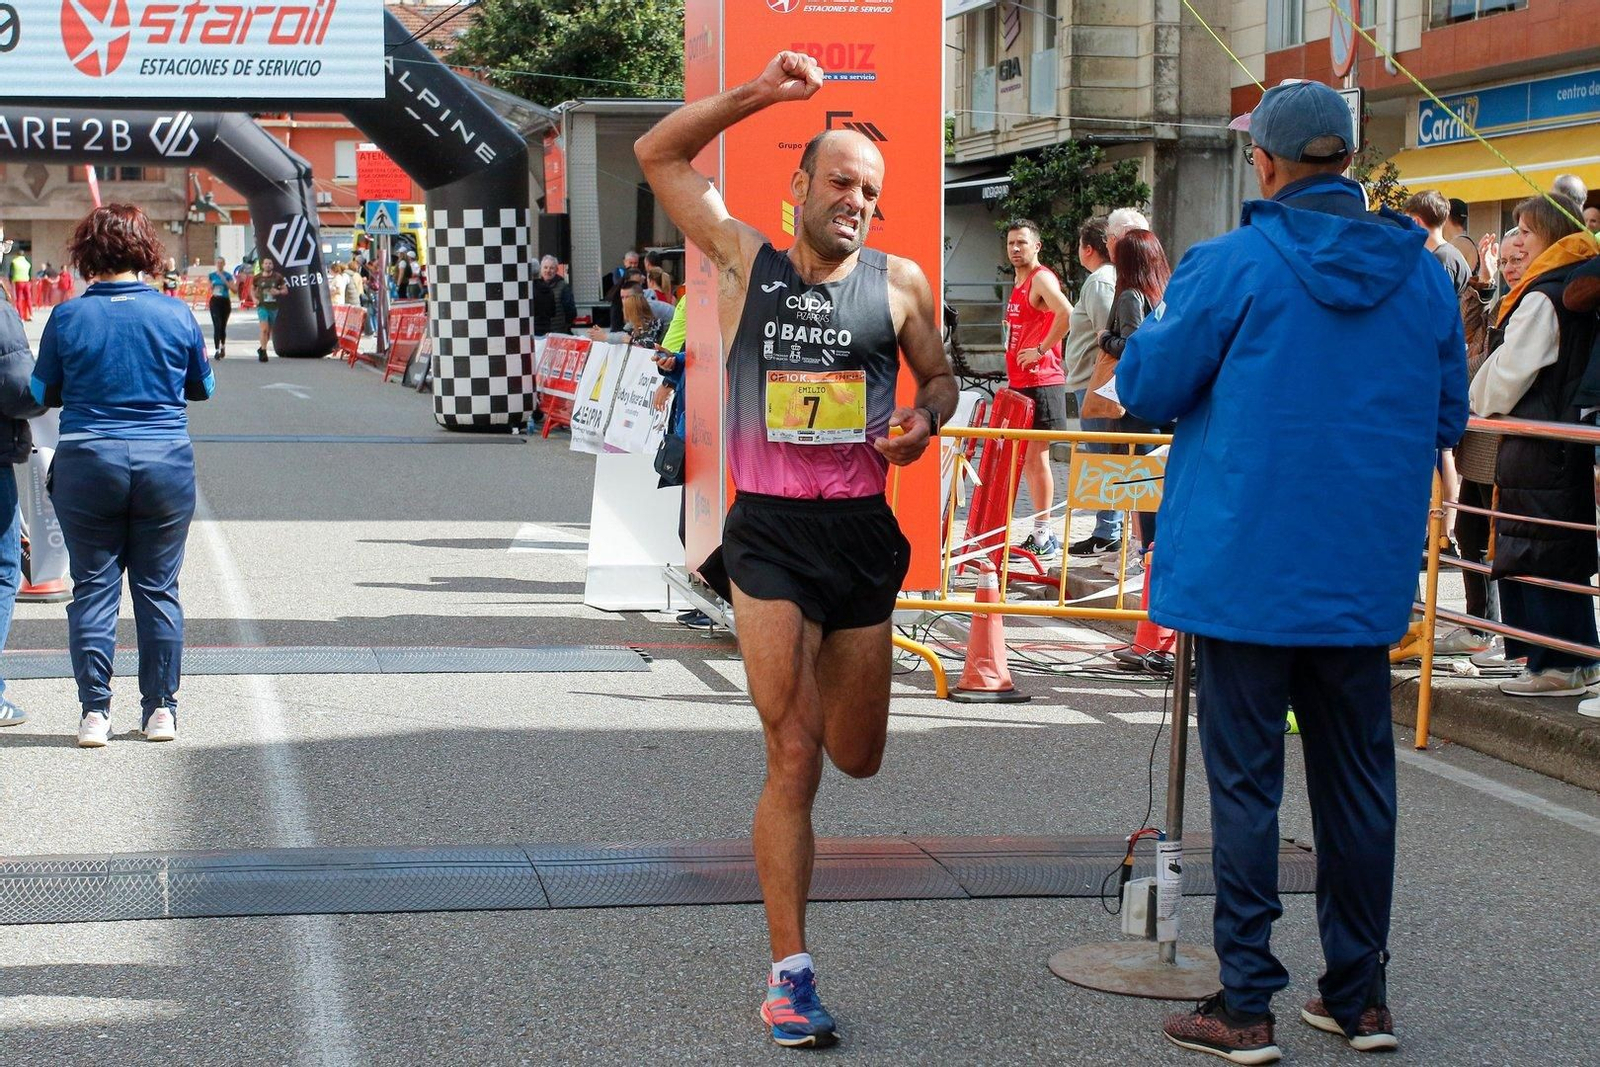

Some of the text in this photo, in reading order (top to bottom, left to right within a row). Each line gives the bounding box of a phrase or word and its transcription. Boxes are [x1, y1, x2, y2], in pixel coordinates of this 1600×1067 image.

[803, 5, 847, 13] ESTACIONES
[139, 0, 338, 45] staroil
[790, 43, 875, 70] ROIZ
[140, 58, 322, 76] ESTACIONES DE SERVICIO
[1556, 80, 1600, 101] centro de
[1419, 105, 1465, 143] Carril
[778, 142, 803, 150] Grupo
[786, 295, 834, 313] CUPA
[796, 311, 830, 323] PIZARRAS
[780, 323, 852, 346] BARCO
[798, 386, 826, 394] EMILIO
[803, 396, 820, 429] 7
